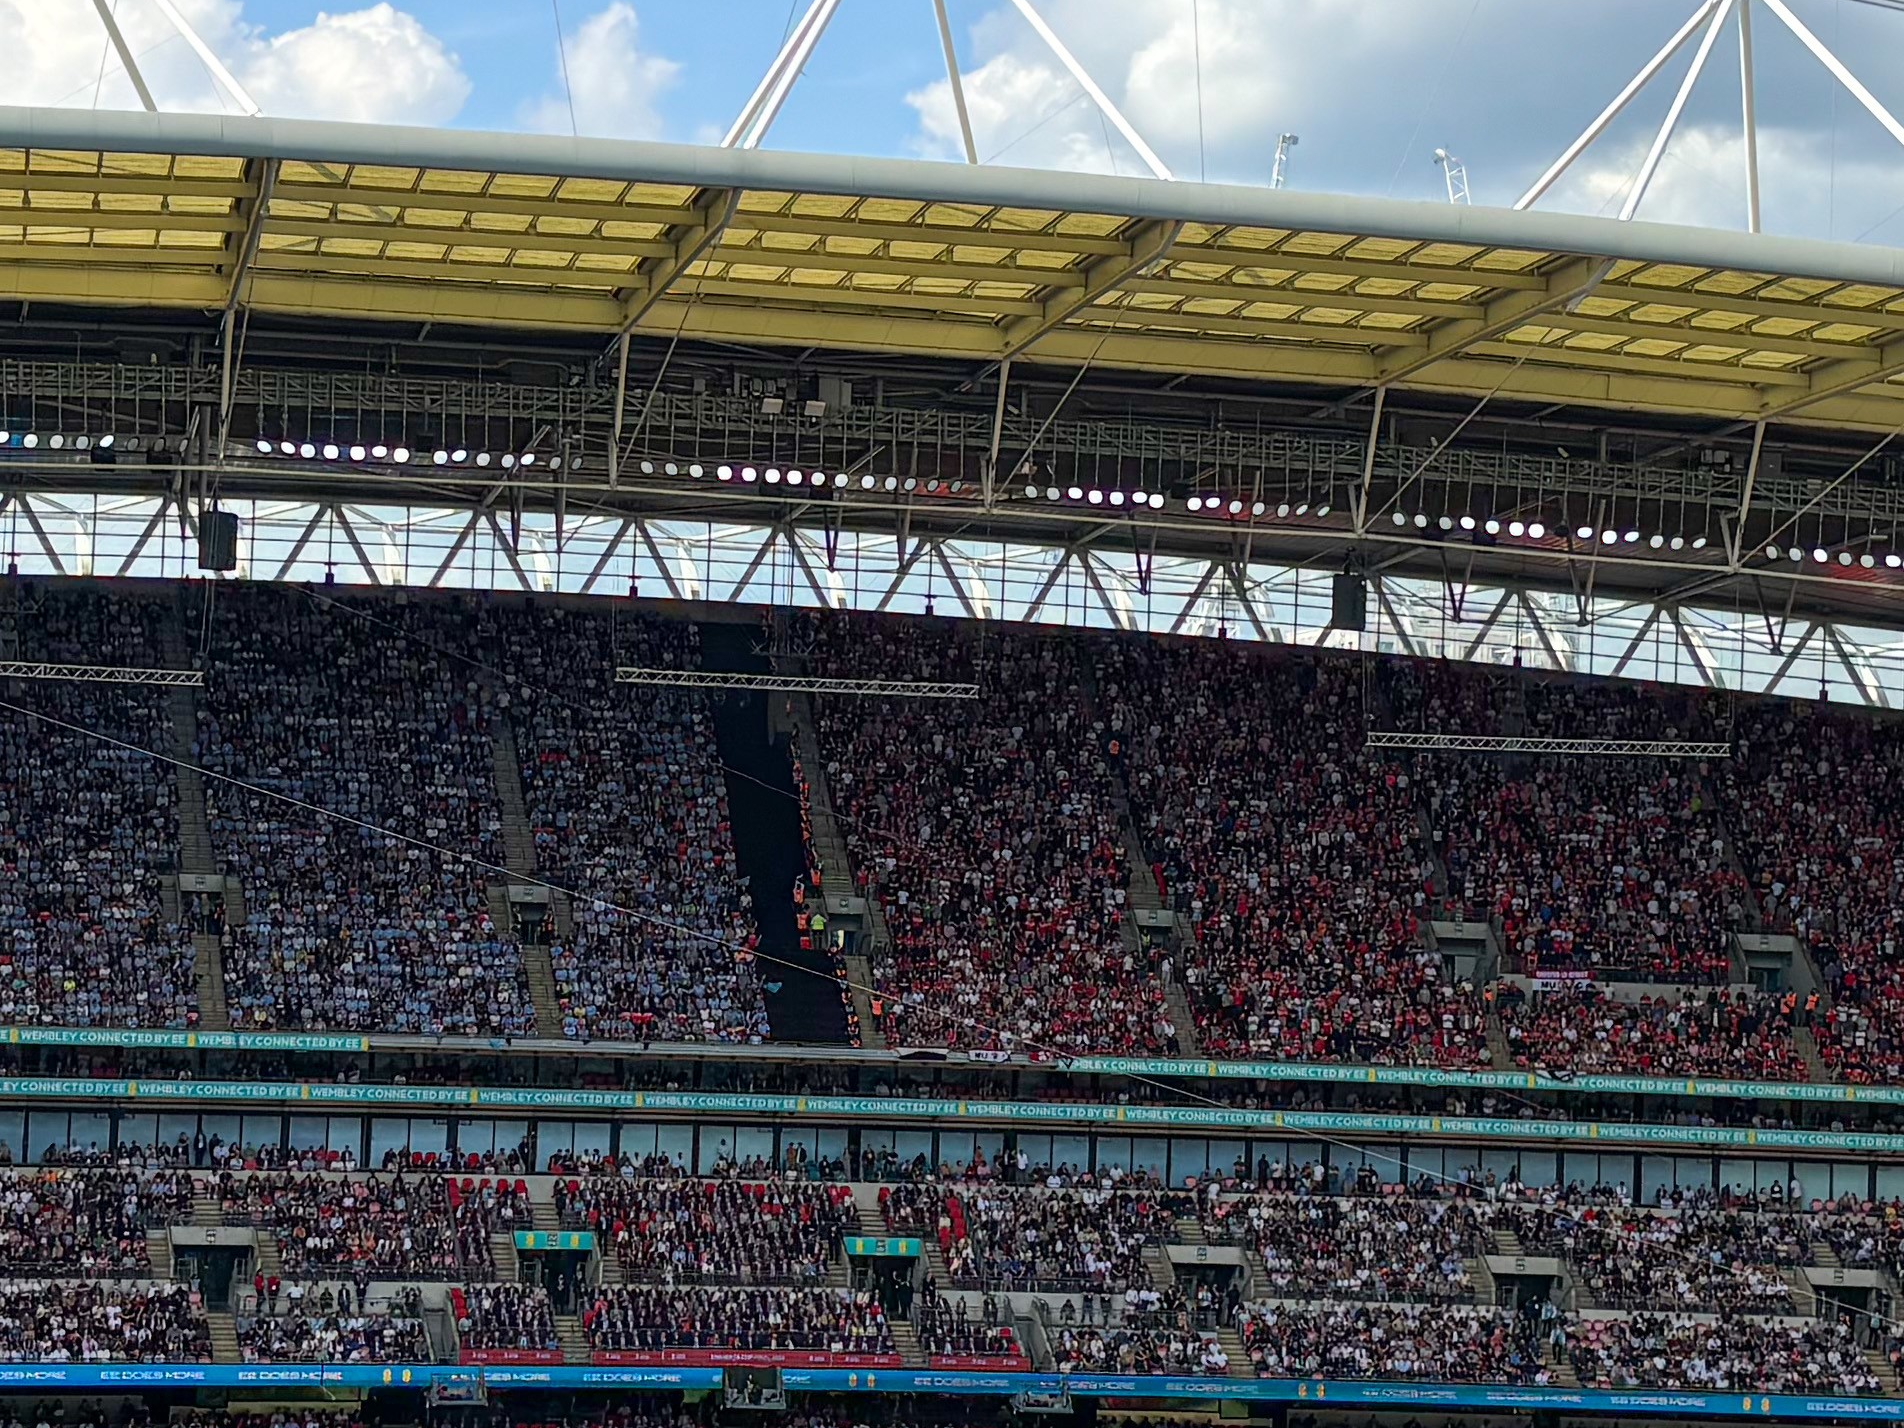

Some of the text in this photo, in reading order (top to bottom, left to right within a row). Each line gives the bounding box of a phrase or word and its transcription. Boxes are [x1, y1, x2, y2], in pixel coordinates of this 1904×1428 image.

[138, 1084, 194, 1094] WEMBLEY
[196, 1085, 266, 1095] CONNECTED
[1696, 1083, 1746, 1094] WEMBLEY
[1748, 1085, 1814, 1097] CONNECTED
